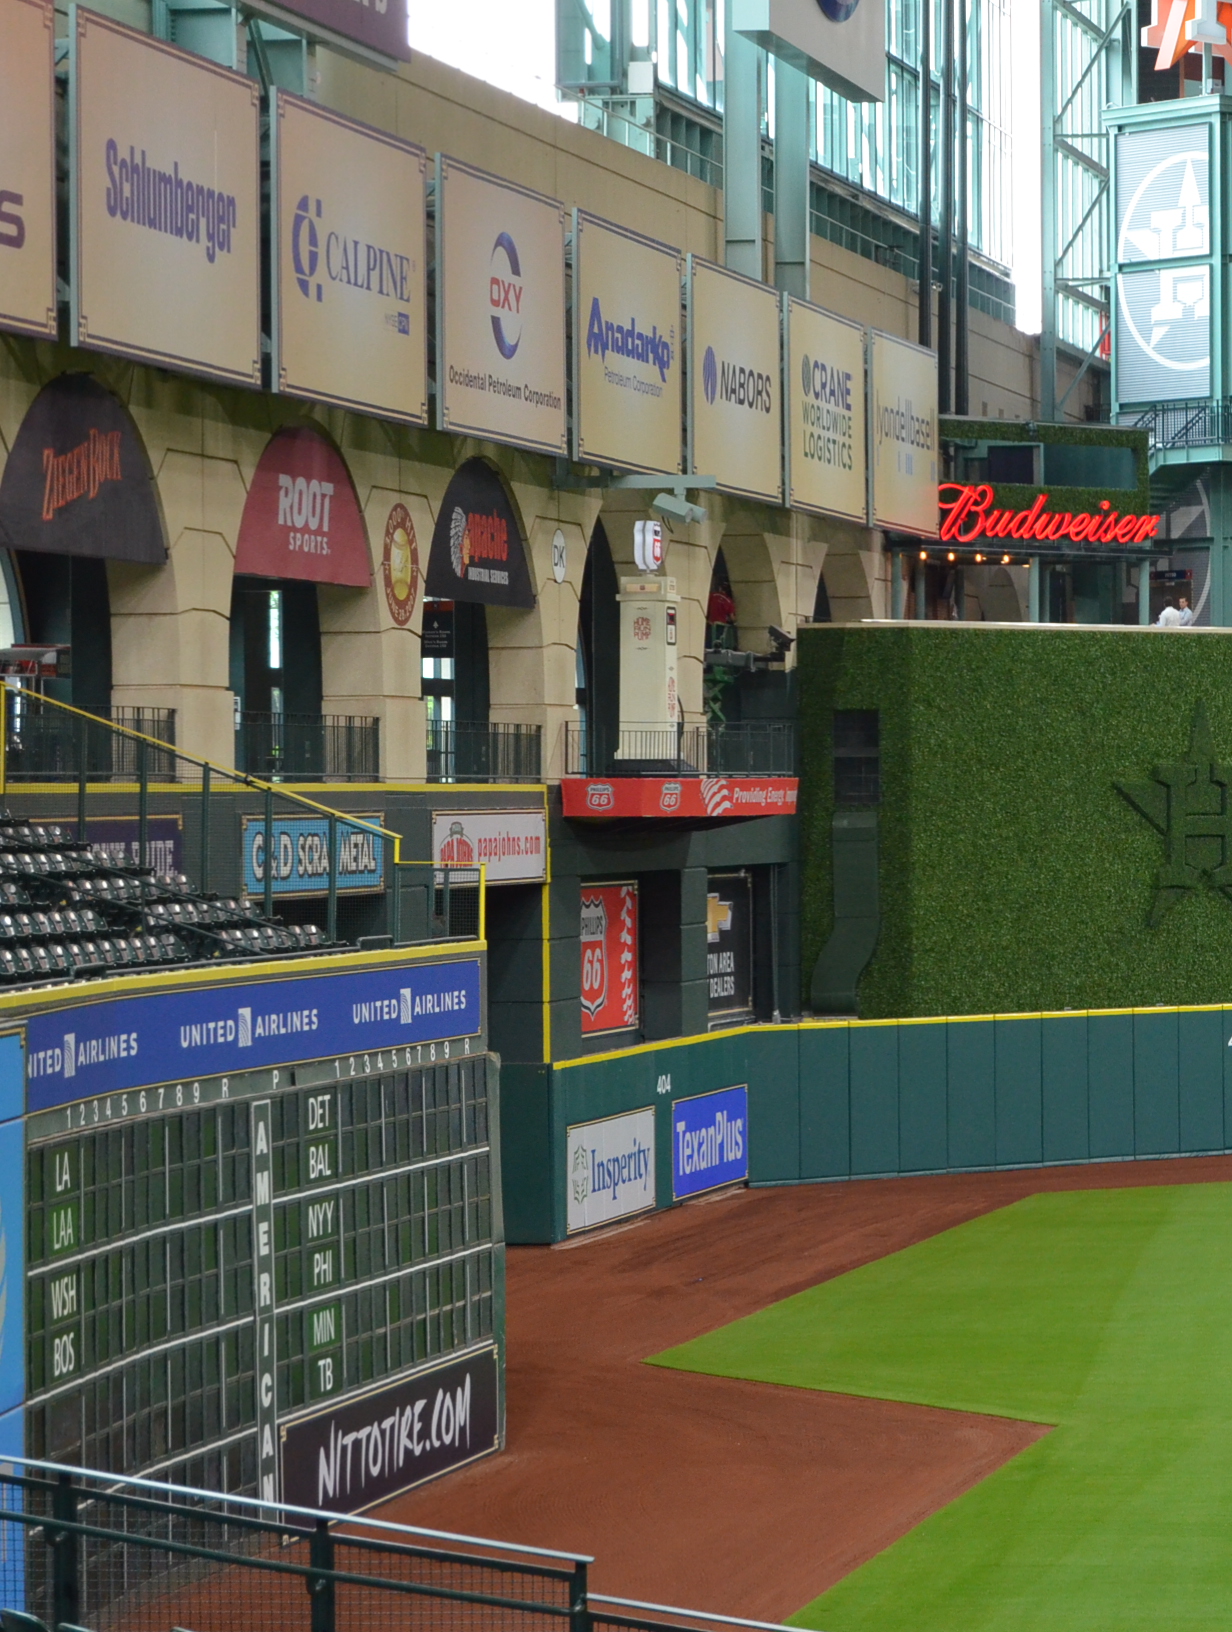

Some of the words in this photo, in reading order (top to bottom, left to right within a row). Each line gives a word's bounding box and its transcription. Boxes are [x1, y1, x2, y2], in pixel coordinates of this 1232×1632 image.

[105, 137, 237, 264] Schlumberger
[325, 231, 412, 304] CALPINE
[489, 276, 523, 314] OXY
[586, 296, 671, 383] Anadarko
[449, 364, 487, 391] Occidental
[488, 373, 523, 401] Petroleum
[523, 383, 562, 411] Corporation
[604, 366, 632, 391] Petroleum
[632, 375, 664, 399] Corporation
[720, 360, 772, 414] NABORS
[812, 359, 853, 412] CRANE
[801, 400, 853, 440] WORLDWIDE
[803, 429, 853, 471] LOGISTICS
[278, 473, 334, 532] ROOT
[938, 483, 1161, 544] Budweiser
[468, 508, 509, 562] apache
[467, 566, 490, 583] INDUSTRIAL
[552, 543, 565, 569] DK
[591, 794, 608, 805] 66
[662, 794, 677, 805] 66
[733, 787, 767, 806] Providing
[339, 832, 377, 873] METAL
[477, 831, 541, 863] papajohns.com
[583, 948, 602, 991] 66
[719, 951, 735, 973] AREA
[352, 998, 399, 1025] UNITED
[413, 989, 467, 1016] AIRLINES
[710, 975, 735, 998] DEALERS
[180, 1018, 236, 1049] UNITED
[254, 1008, 319, 1038] AIRLINES
[77, 1032, 139, 1067] AIRLINES
[334, 1059, 340, 1078] 1
[349, 1056, 356, 1076] 2
[363, 1054, 370, 1073] 3
[376, 1052, 383, 1071] 4
[391, 1050, 398, 1068] 5
[405, 1048, 412, 1066] 6
[416, 1046, 422, 1063] 7
[429, 1043, 436, 1062] 8
[443, 1041, 450, 1059] 9
[464, 1037, 471, 1055] R
[66, 1107, 71, 1128] 1
[80, 1104, 86, 1126] 2
[93, 1100, 99, 1122] 3
[105, 1097, 112, 1119] 4
[121, 1094, 128, 1116] 5
[139, 1091, 147, 1113] 6
[157, 1088, 165, 1110] 7
[175, 1084, 184, 1106] 8
[193, 1082, 200, 1103] 9
[221, 1078, 230, 1099] R
[272, 1070, 280, 1090] P
[656, 1073, 671, 1094] 404
[308, 1094, 331, 1130] DET
[309, 1144, 332, 1179] BAL
[676, 1110, 743, 1176] TexanPlus
[55, 1151, 71, 1192] LA
[590, 1136, 651, 1201] Insperity
[53, 1207, 74, 1251] LAA
[308, 1201, 335, 1240] NYY
[313, 1252, 333, 1287] PHI
[51, 1273, 77, 1321] WSH
[312, 1306, 335, 1346] MIN
[53, 1332, 75, 1378] BOS
[317, 1356, 333, 1393] TB
[318, 1372, 472, 1507] NITTOTIRE.COM
